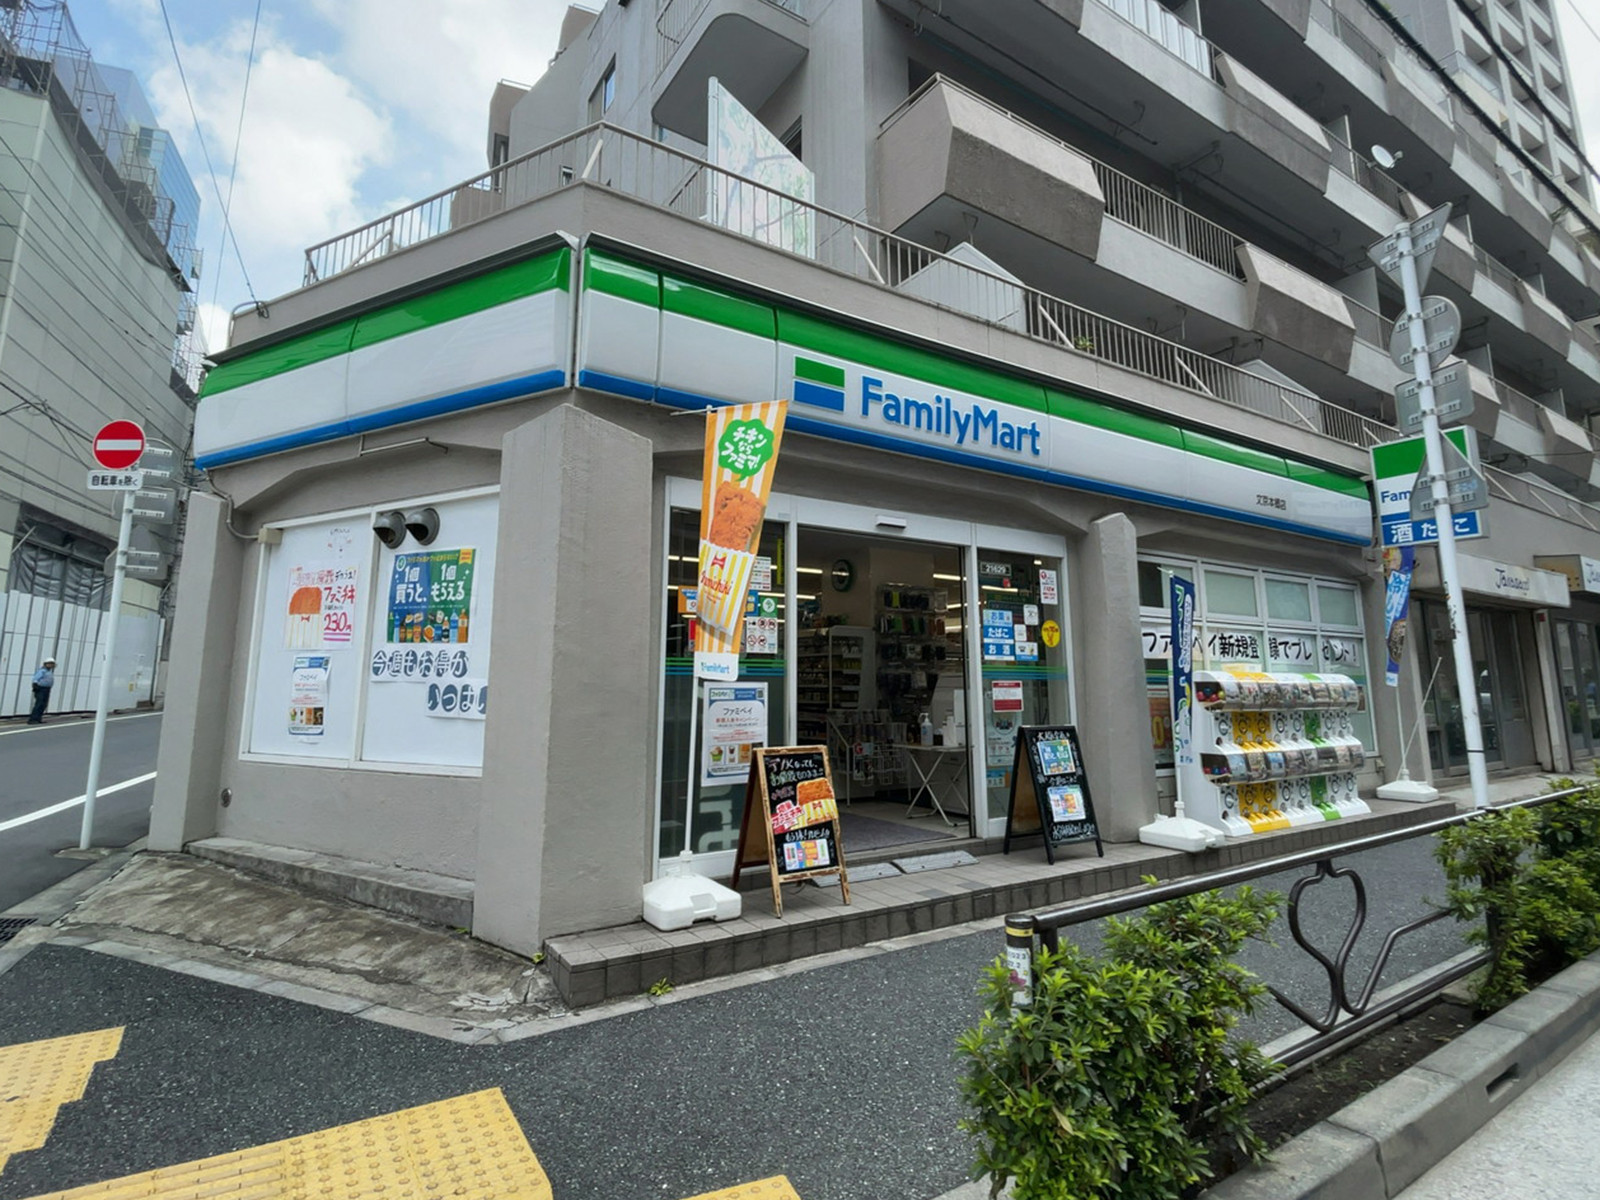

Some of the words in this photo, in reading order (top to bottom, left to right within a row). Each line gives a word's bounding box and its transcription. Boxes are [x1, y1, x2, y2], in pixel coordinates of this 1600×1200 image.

[861, 375, 1041, 456] FamilyMart
[732, 426, 768, 448] チキン
[91, 474, 138, 486] 自転車を除く
[1390, 522, 1414, 543] 酒
[430, 580, 465, 603] もらえる
[987, 627, 1010, 638] たばこ
[372, 649, 469, 678] 今週もお得が
